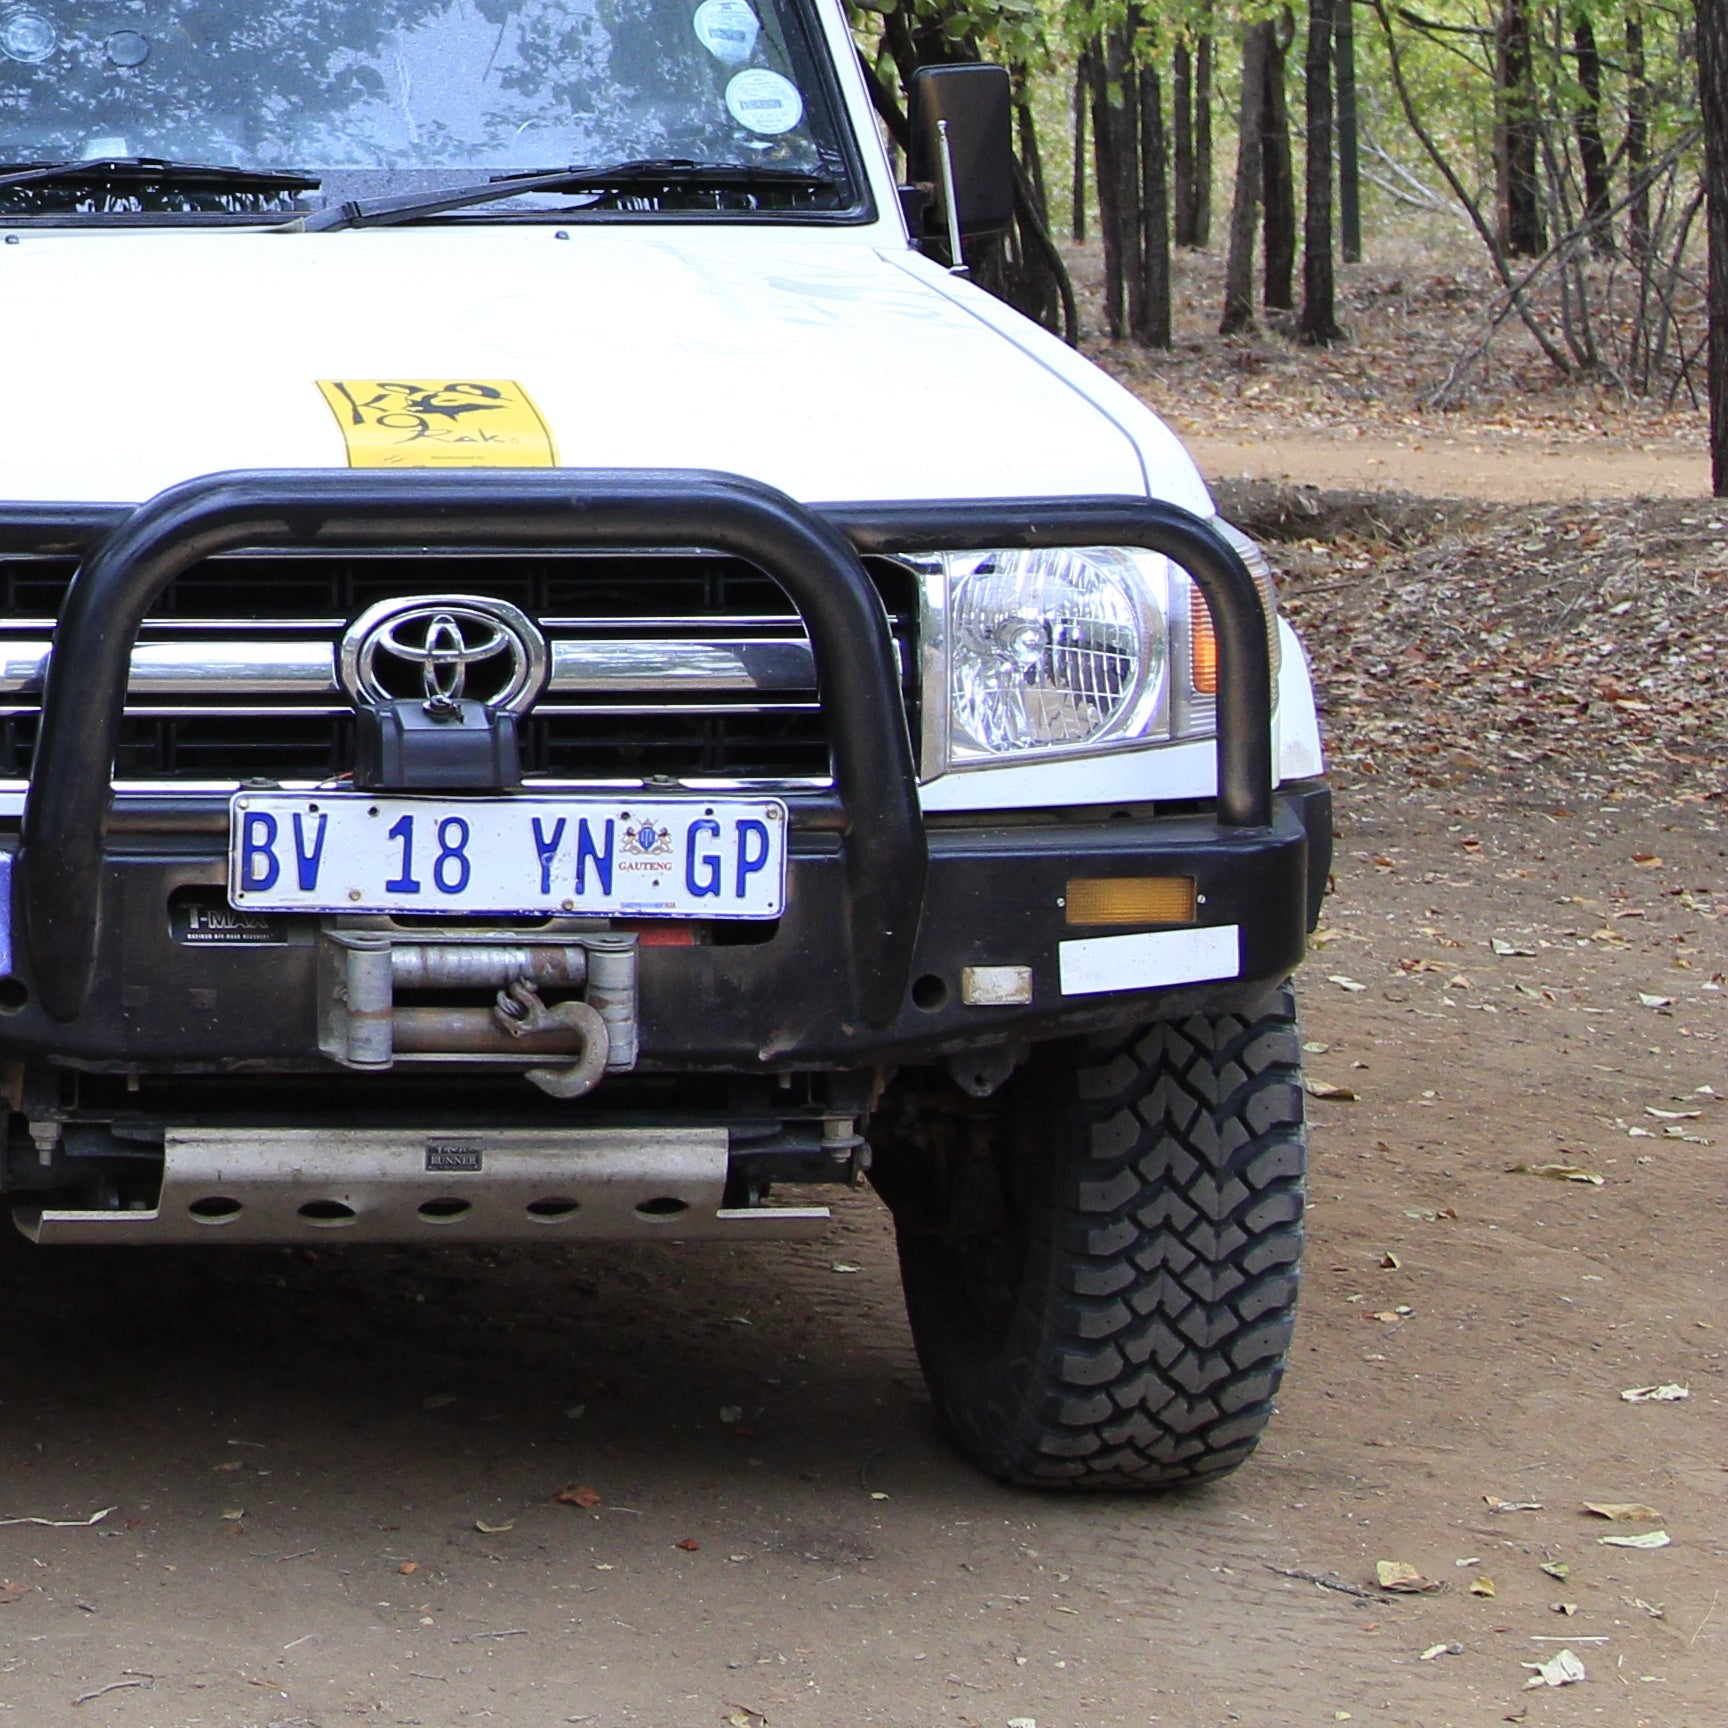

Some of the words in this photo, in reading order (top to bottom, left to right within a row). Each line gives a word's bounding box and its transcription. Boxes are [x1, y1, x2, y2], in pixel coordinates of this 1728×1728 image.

[242, 811, 329, 892] BV
[384, 814, 471, 895] 18
[531, 816, 615, 896] YN
[685, 818, 770, 899] GP
[618, 861, 673, 871] GAUTENG
[431, 1154, 477, 1165] RUNNER
